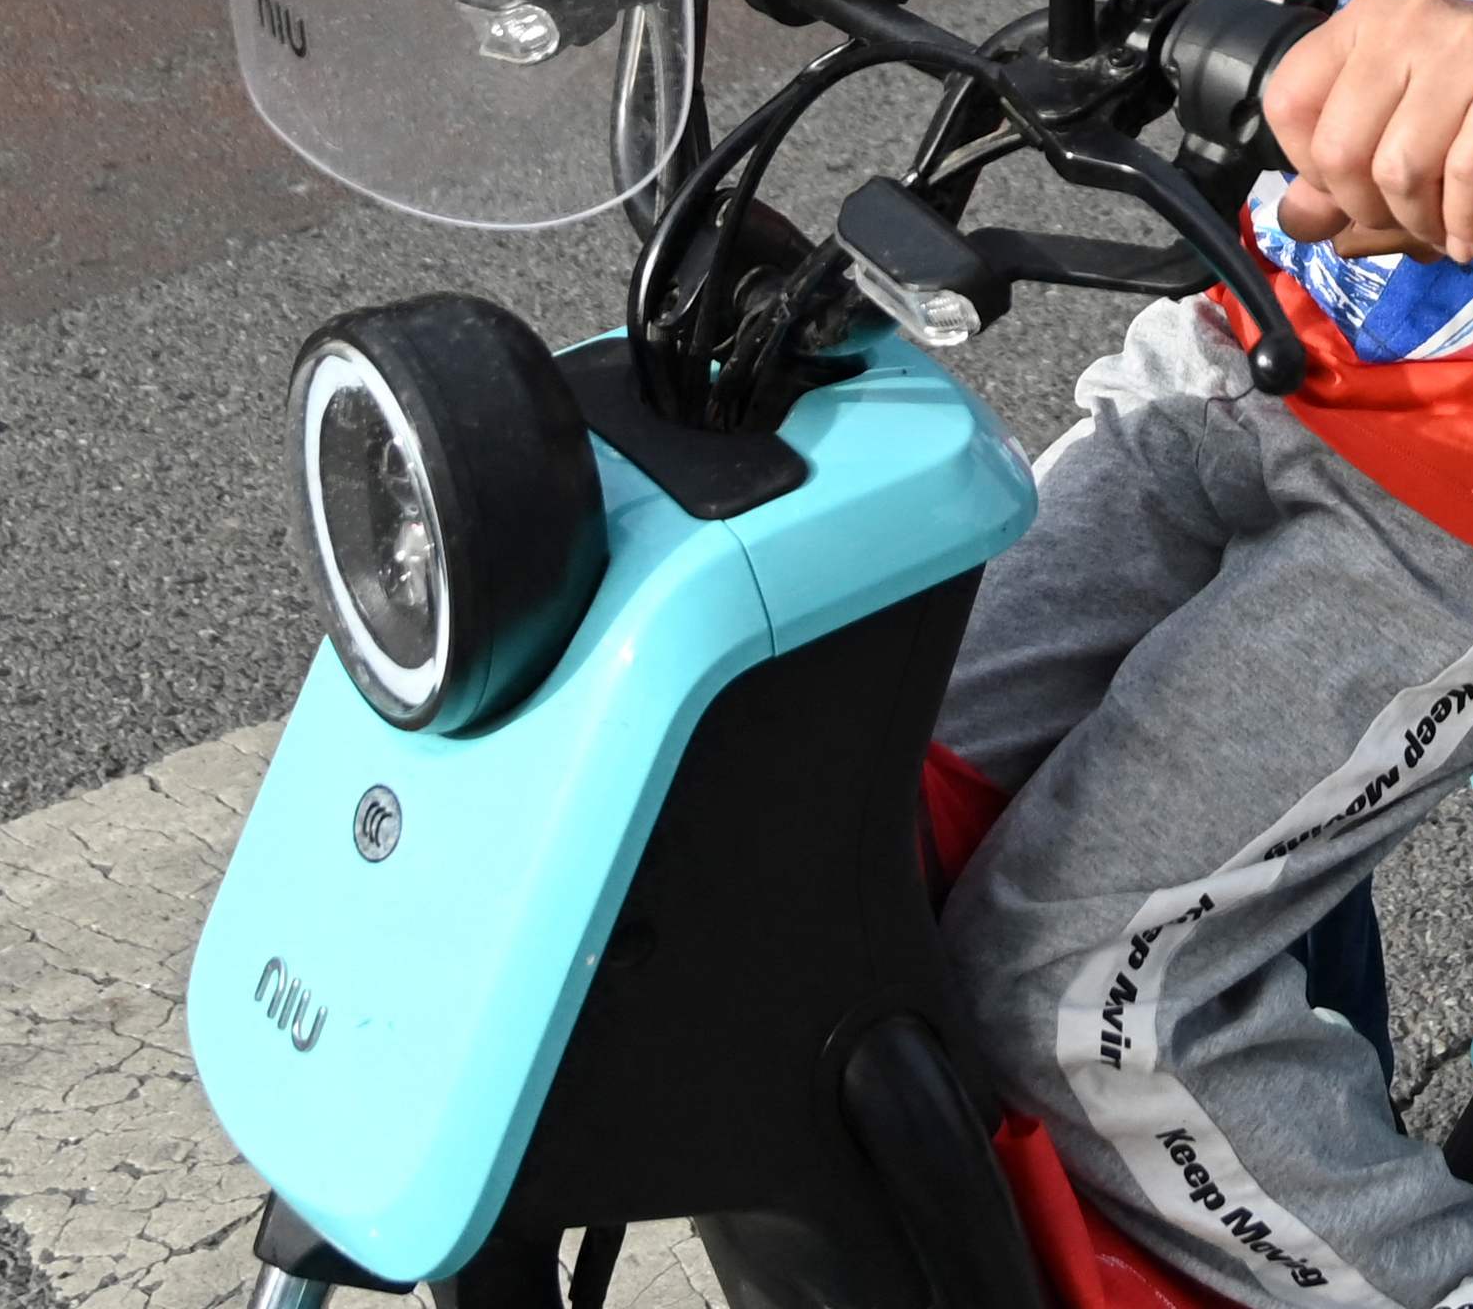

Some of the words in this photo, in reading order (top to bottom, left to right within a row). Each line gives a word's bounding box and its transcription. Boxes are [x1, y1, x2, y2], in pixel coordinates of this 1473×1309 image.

[1127, 893, 1217, 971] Kep
[1154, 1127, 1226, 1212] Keep
[1219, 1205, 1329, 1288] Movig
